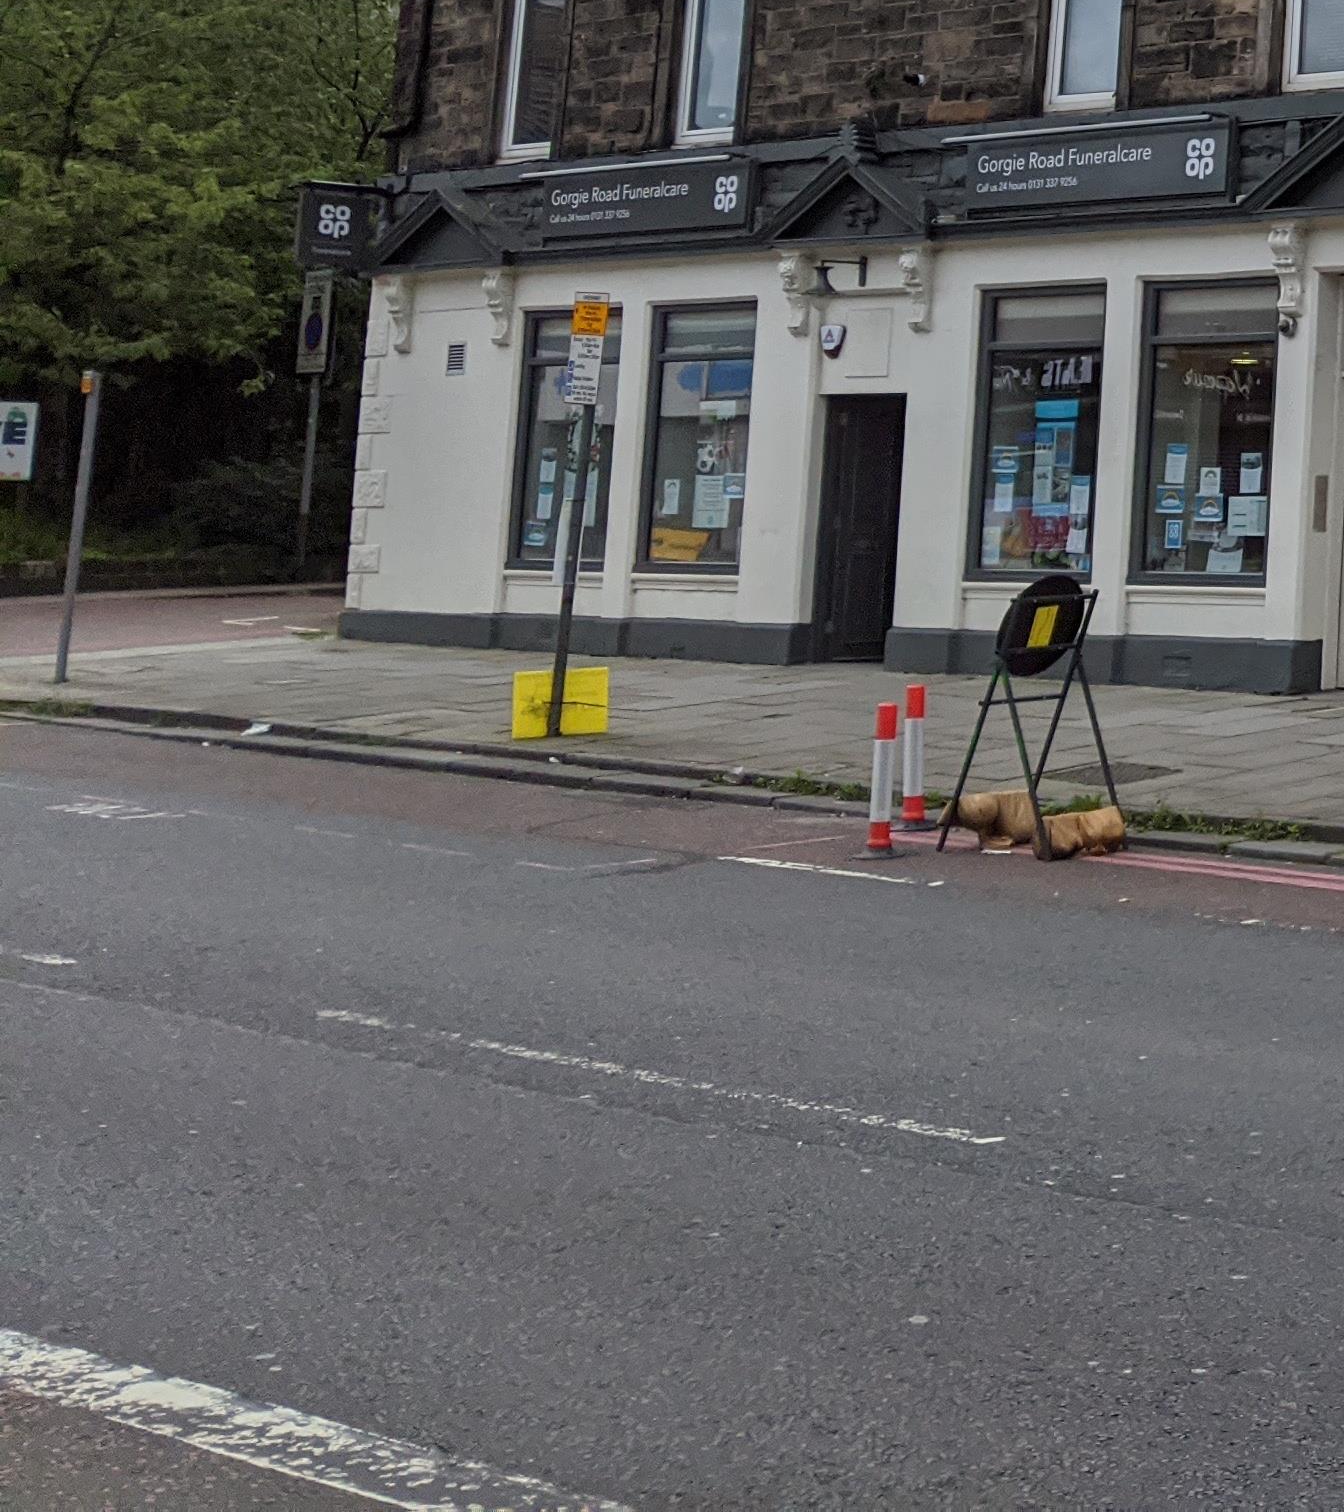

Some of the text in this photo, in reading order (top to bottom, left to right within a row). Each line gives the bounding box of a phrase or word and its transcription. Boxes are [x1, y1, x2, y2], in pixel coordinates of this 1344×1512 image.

[978, 144, 1152, 176] Gorgie Road Funeralcare
[551, 181, 689, 208] Gorgie Road Funeralcare
[976, 183, 989, 193] Call
[990, 184, 998, 192] us
[998, 181, 1008, 191] 24
[1008, 181, 1027, 190] hours
[1028, 179, 1044, 189] 0131
[1045, 177, 1058, 188] 337
